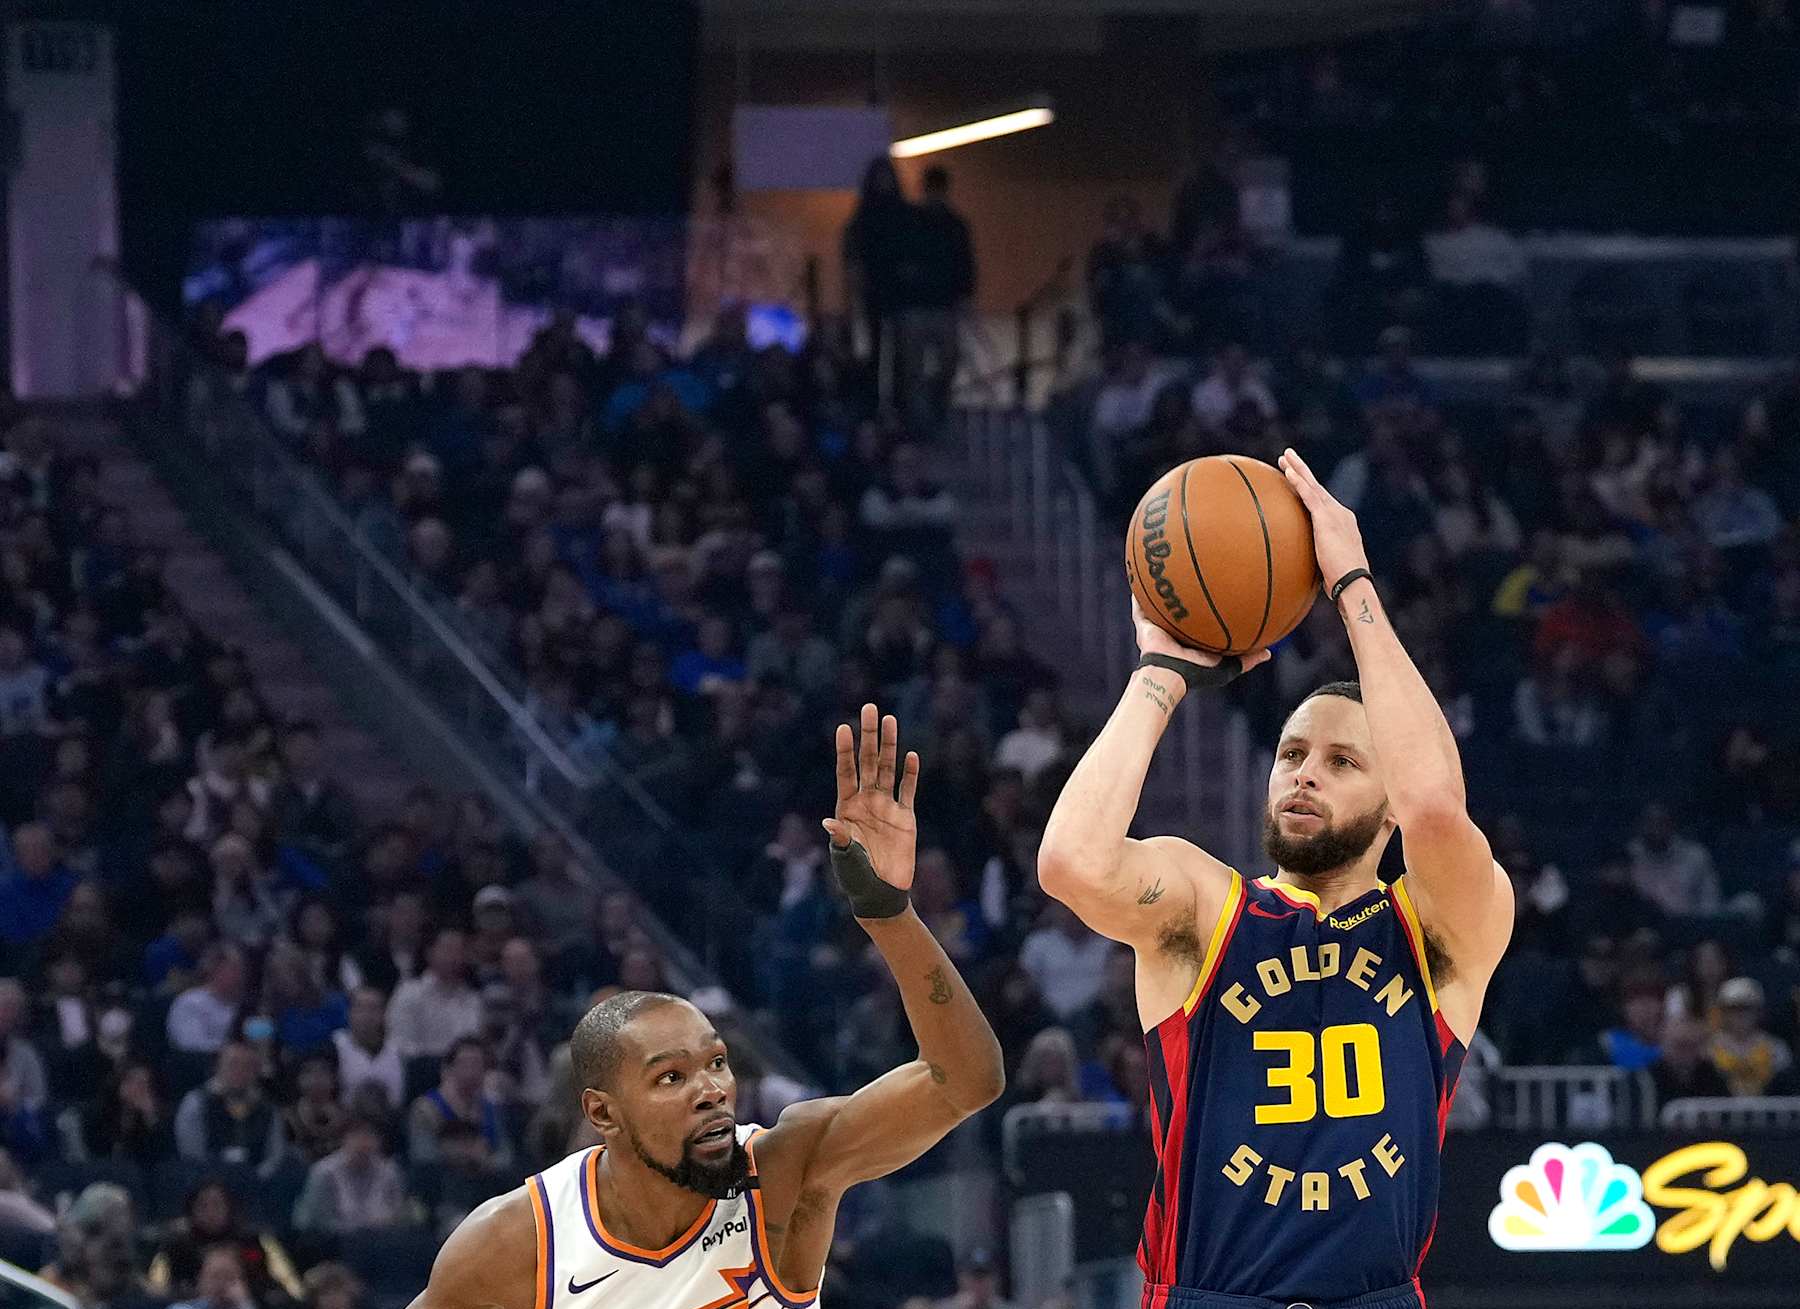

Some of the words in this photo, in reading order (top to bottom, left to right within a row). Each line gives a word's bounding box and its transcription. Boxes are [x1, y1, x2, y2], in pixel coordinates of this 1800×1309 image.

[1142, 489, 1189, 622] Wilson
[1329, 899, 1390, 930] Rakuten
[1220, 942, 1415, 1024] GOLDEN
[1253, 1023, 1385, 1125] 30
[1221, 1132, 1406, 1211] STATE
[1641, 1141, 1800, 1273] Sp
[702, 1216, 748, 1252] PayPal
